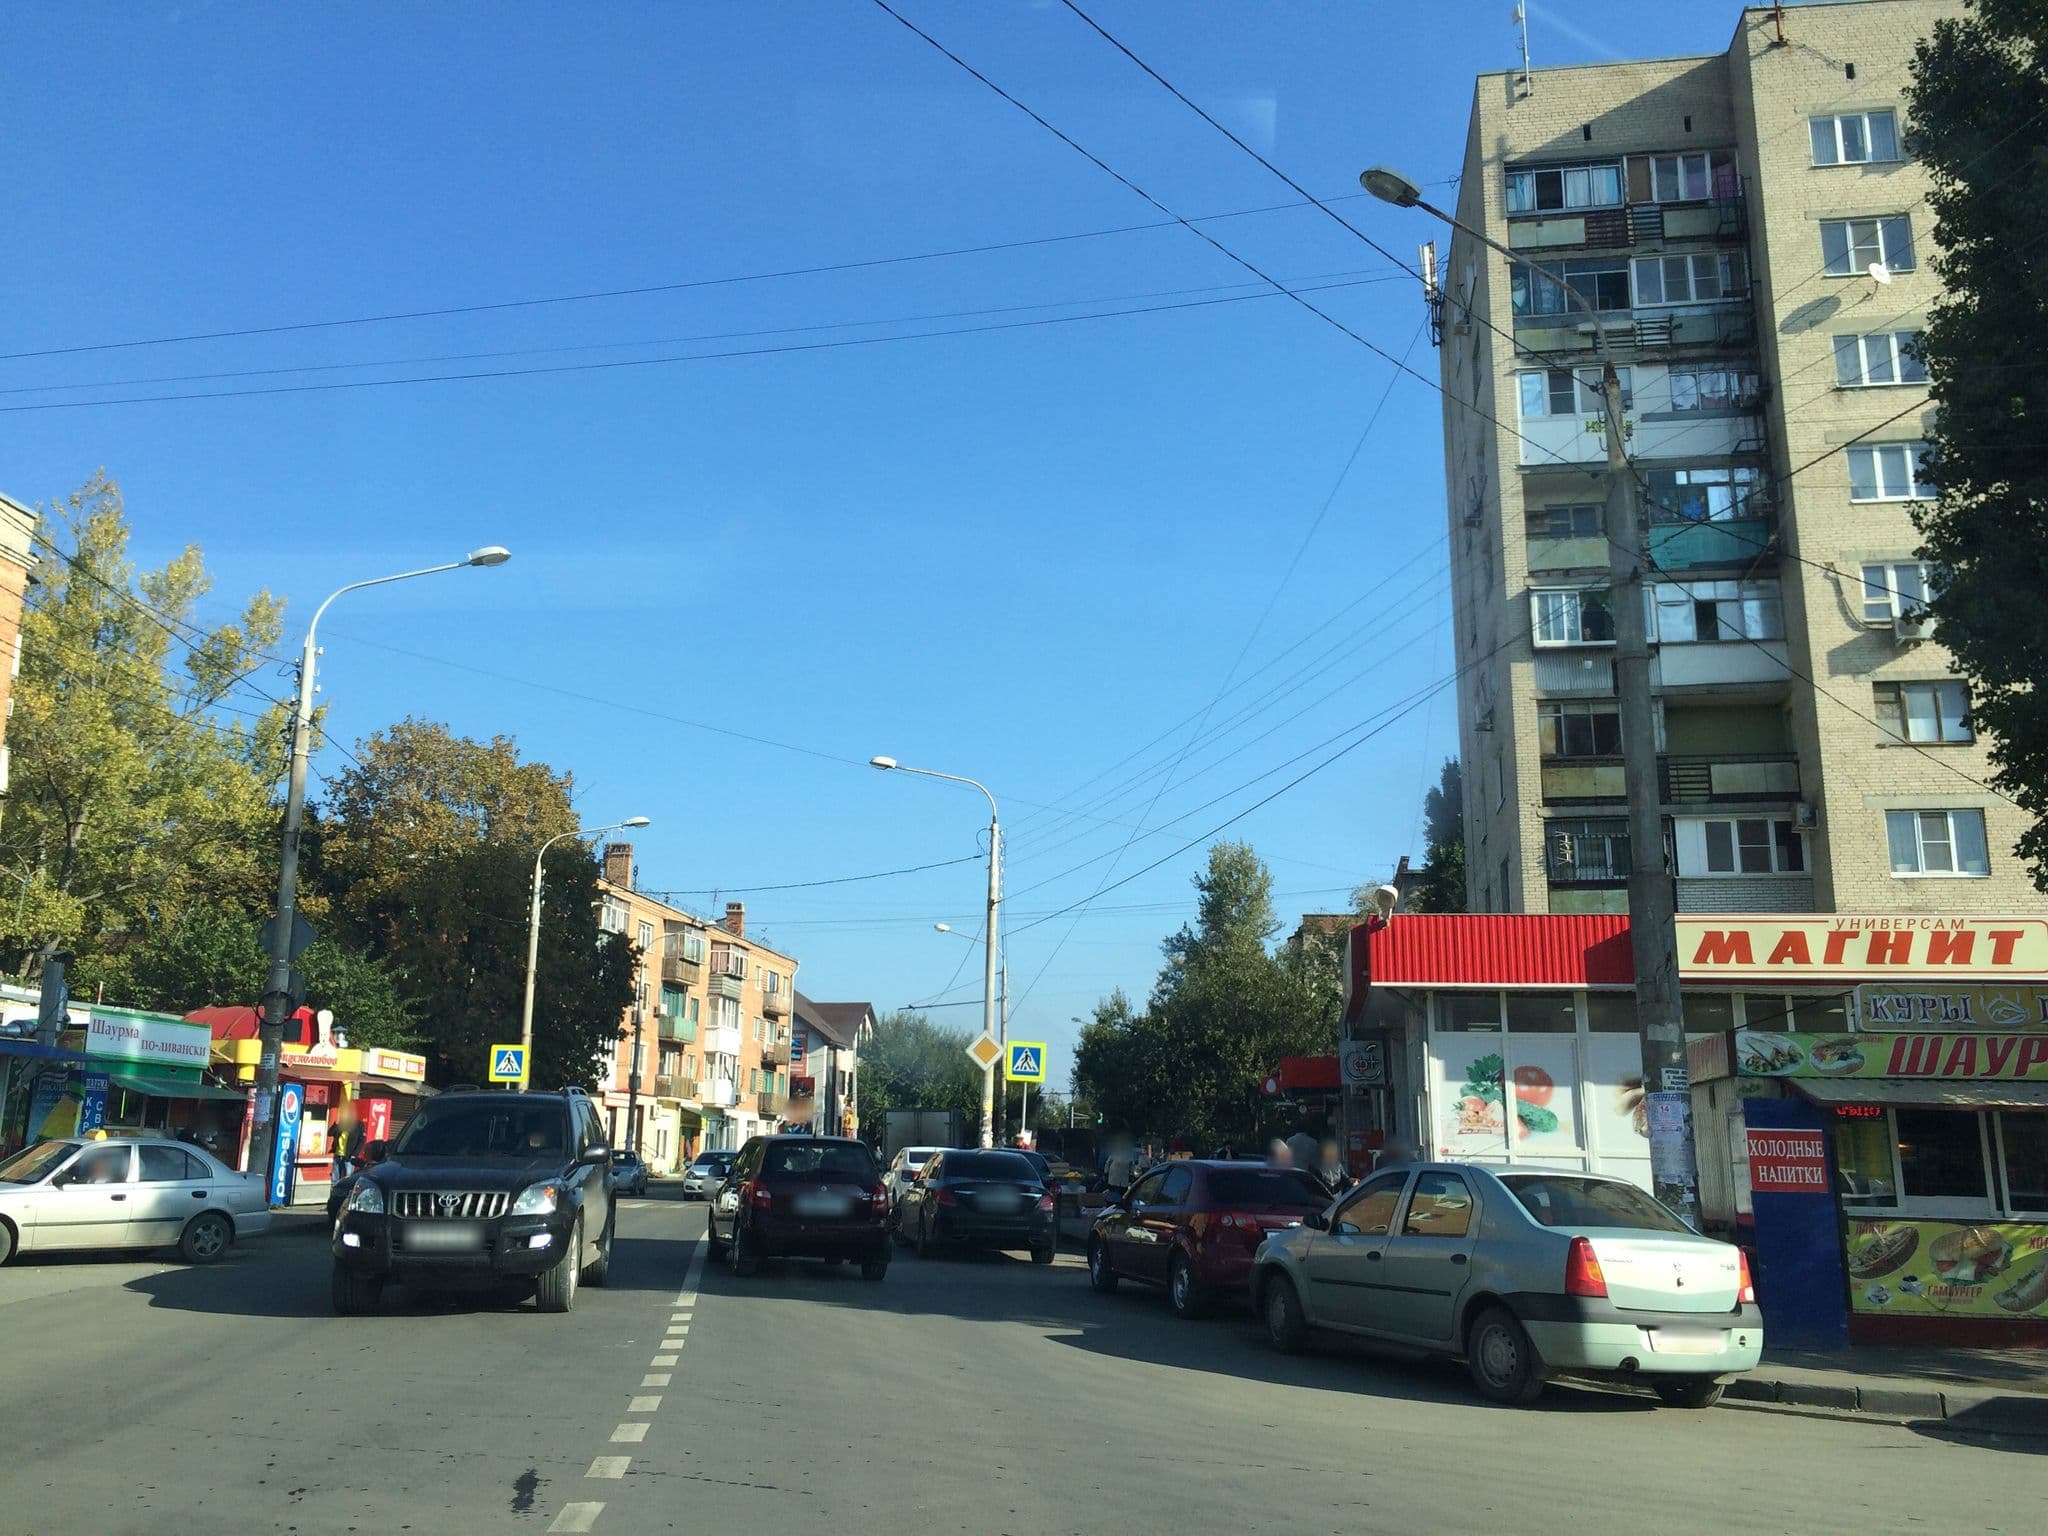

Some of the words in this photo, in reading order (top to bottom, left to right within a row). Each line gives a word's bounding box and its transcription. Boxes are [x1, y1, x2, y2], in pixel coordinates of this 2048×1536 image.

[1836, 918, 1965, 931] УНИВЕРСАМ
[1692, 930, 2024, 965] МАГНИТ
[1871, 994, 1976, 1024] КУРЫ
[92, 1018, 139, 1041] Шаурма
[141, 1039, 206, 1056] по-ливански
[1886, 1036, 2048, 1077] ШАУР
[1748, 1139, 1825, 1160] ХОЛОДНЫЕ
[277, 1130, 292, 1198] pepsi
[1758, 1166, 1824, 1184] НАПИТКИ
[1928, 1285, 1983, 1297] ГАМБУРГЕР
